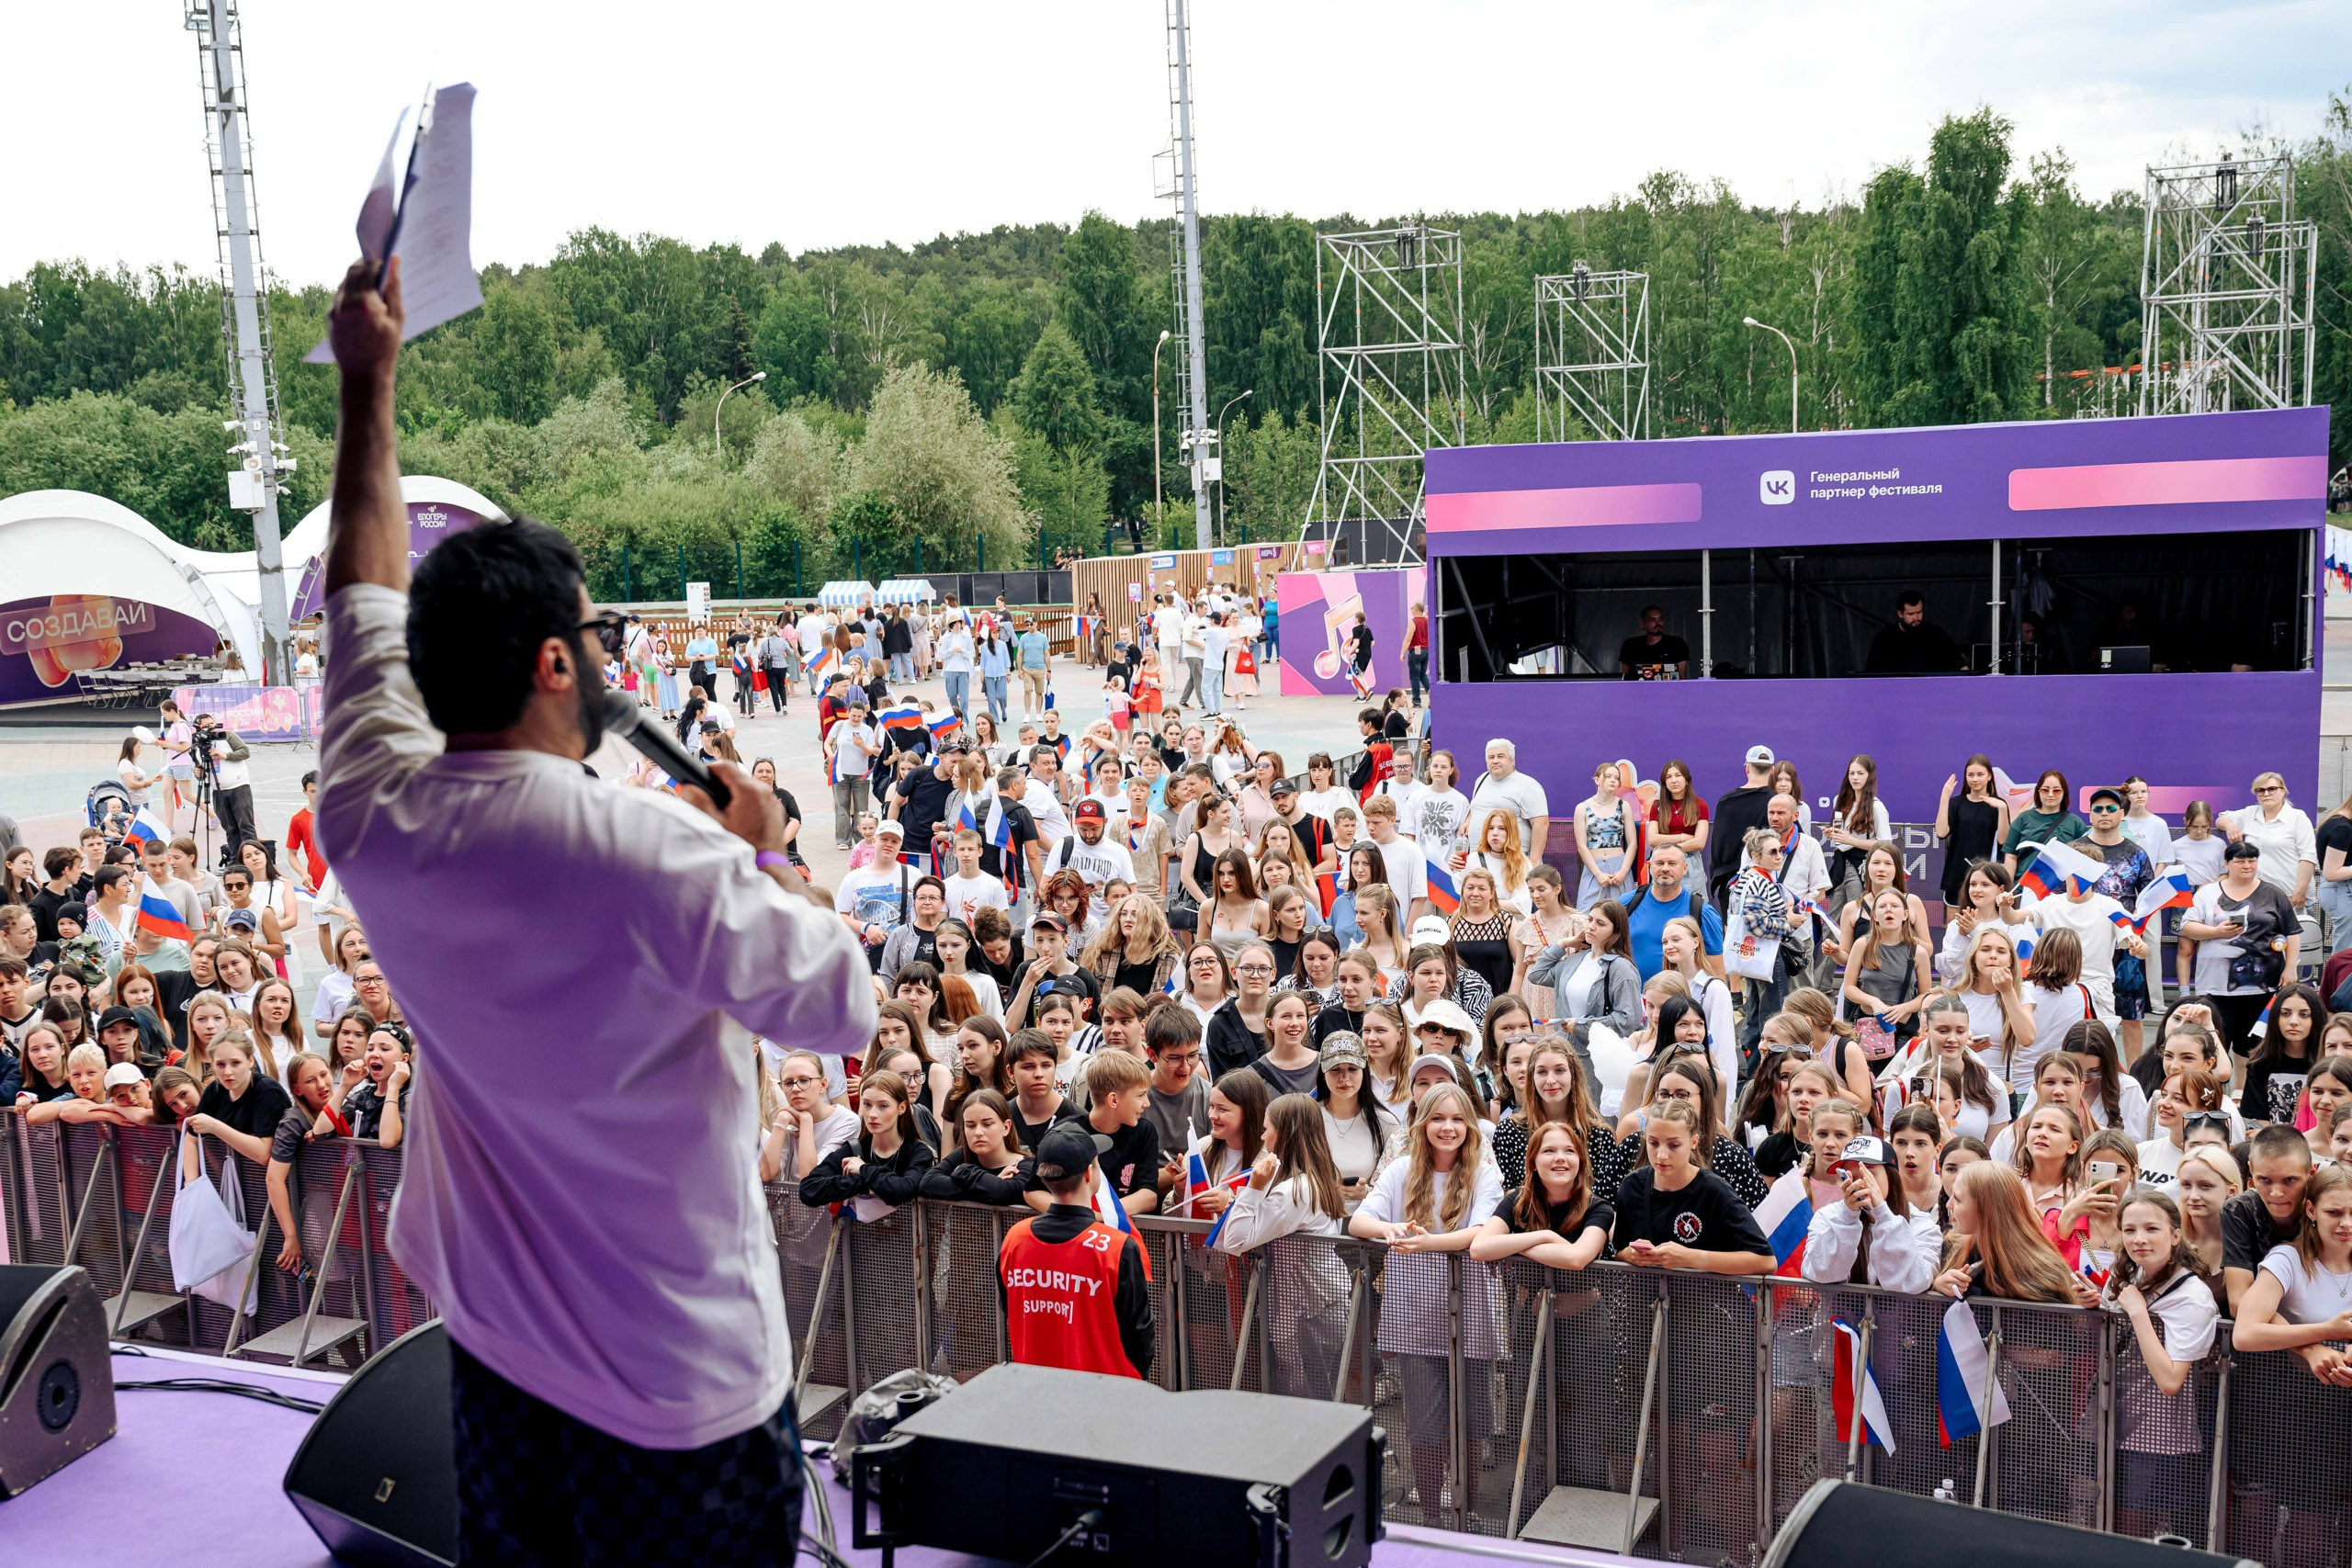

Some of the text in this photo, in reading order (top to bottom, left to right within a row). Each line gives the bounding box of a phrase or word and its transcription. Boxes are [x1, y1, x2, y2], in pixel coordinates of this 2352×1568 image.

[1810, 467, 1900, 484] Генеральный
[1766, 479, 1789, 495] VK
[1810, 483, 1943, 501] партнер фестиваля
[420, 520, 447, 528] РОССИИ
[6, 599, 147, 643] СОЗДАВАЙ
[1091, 858, 1113, 880] TRIP
[1081, 1229, 1112, 1252] 23
[1007, 1268, 1102, 1297] SECURITY
